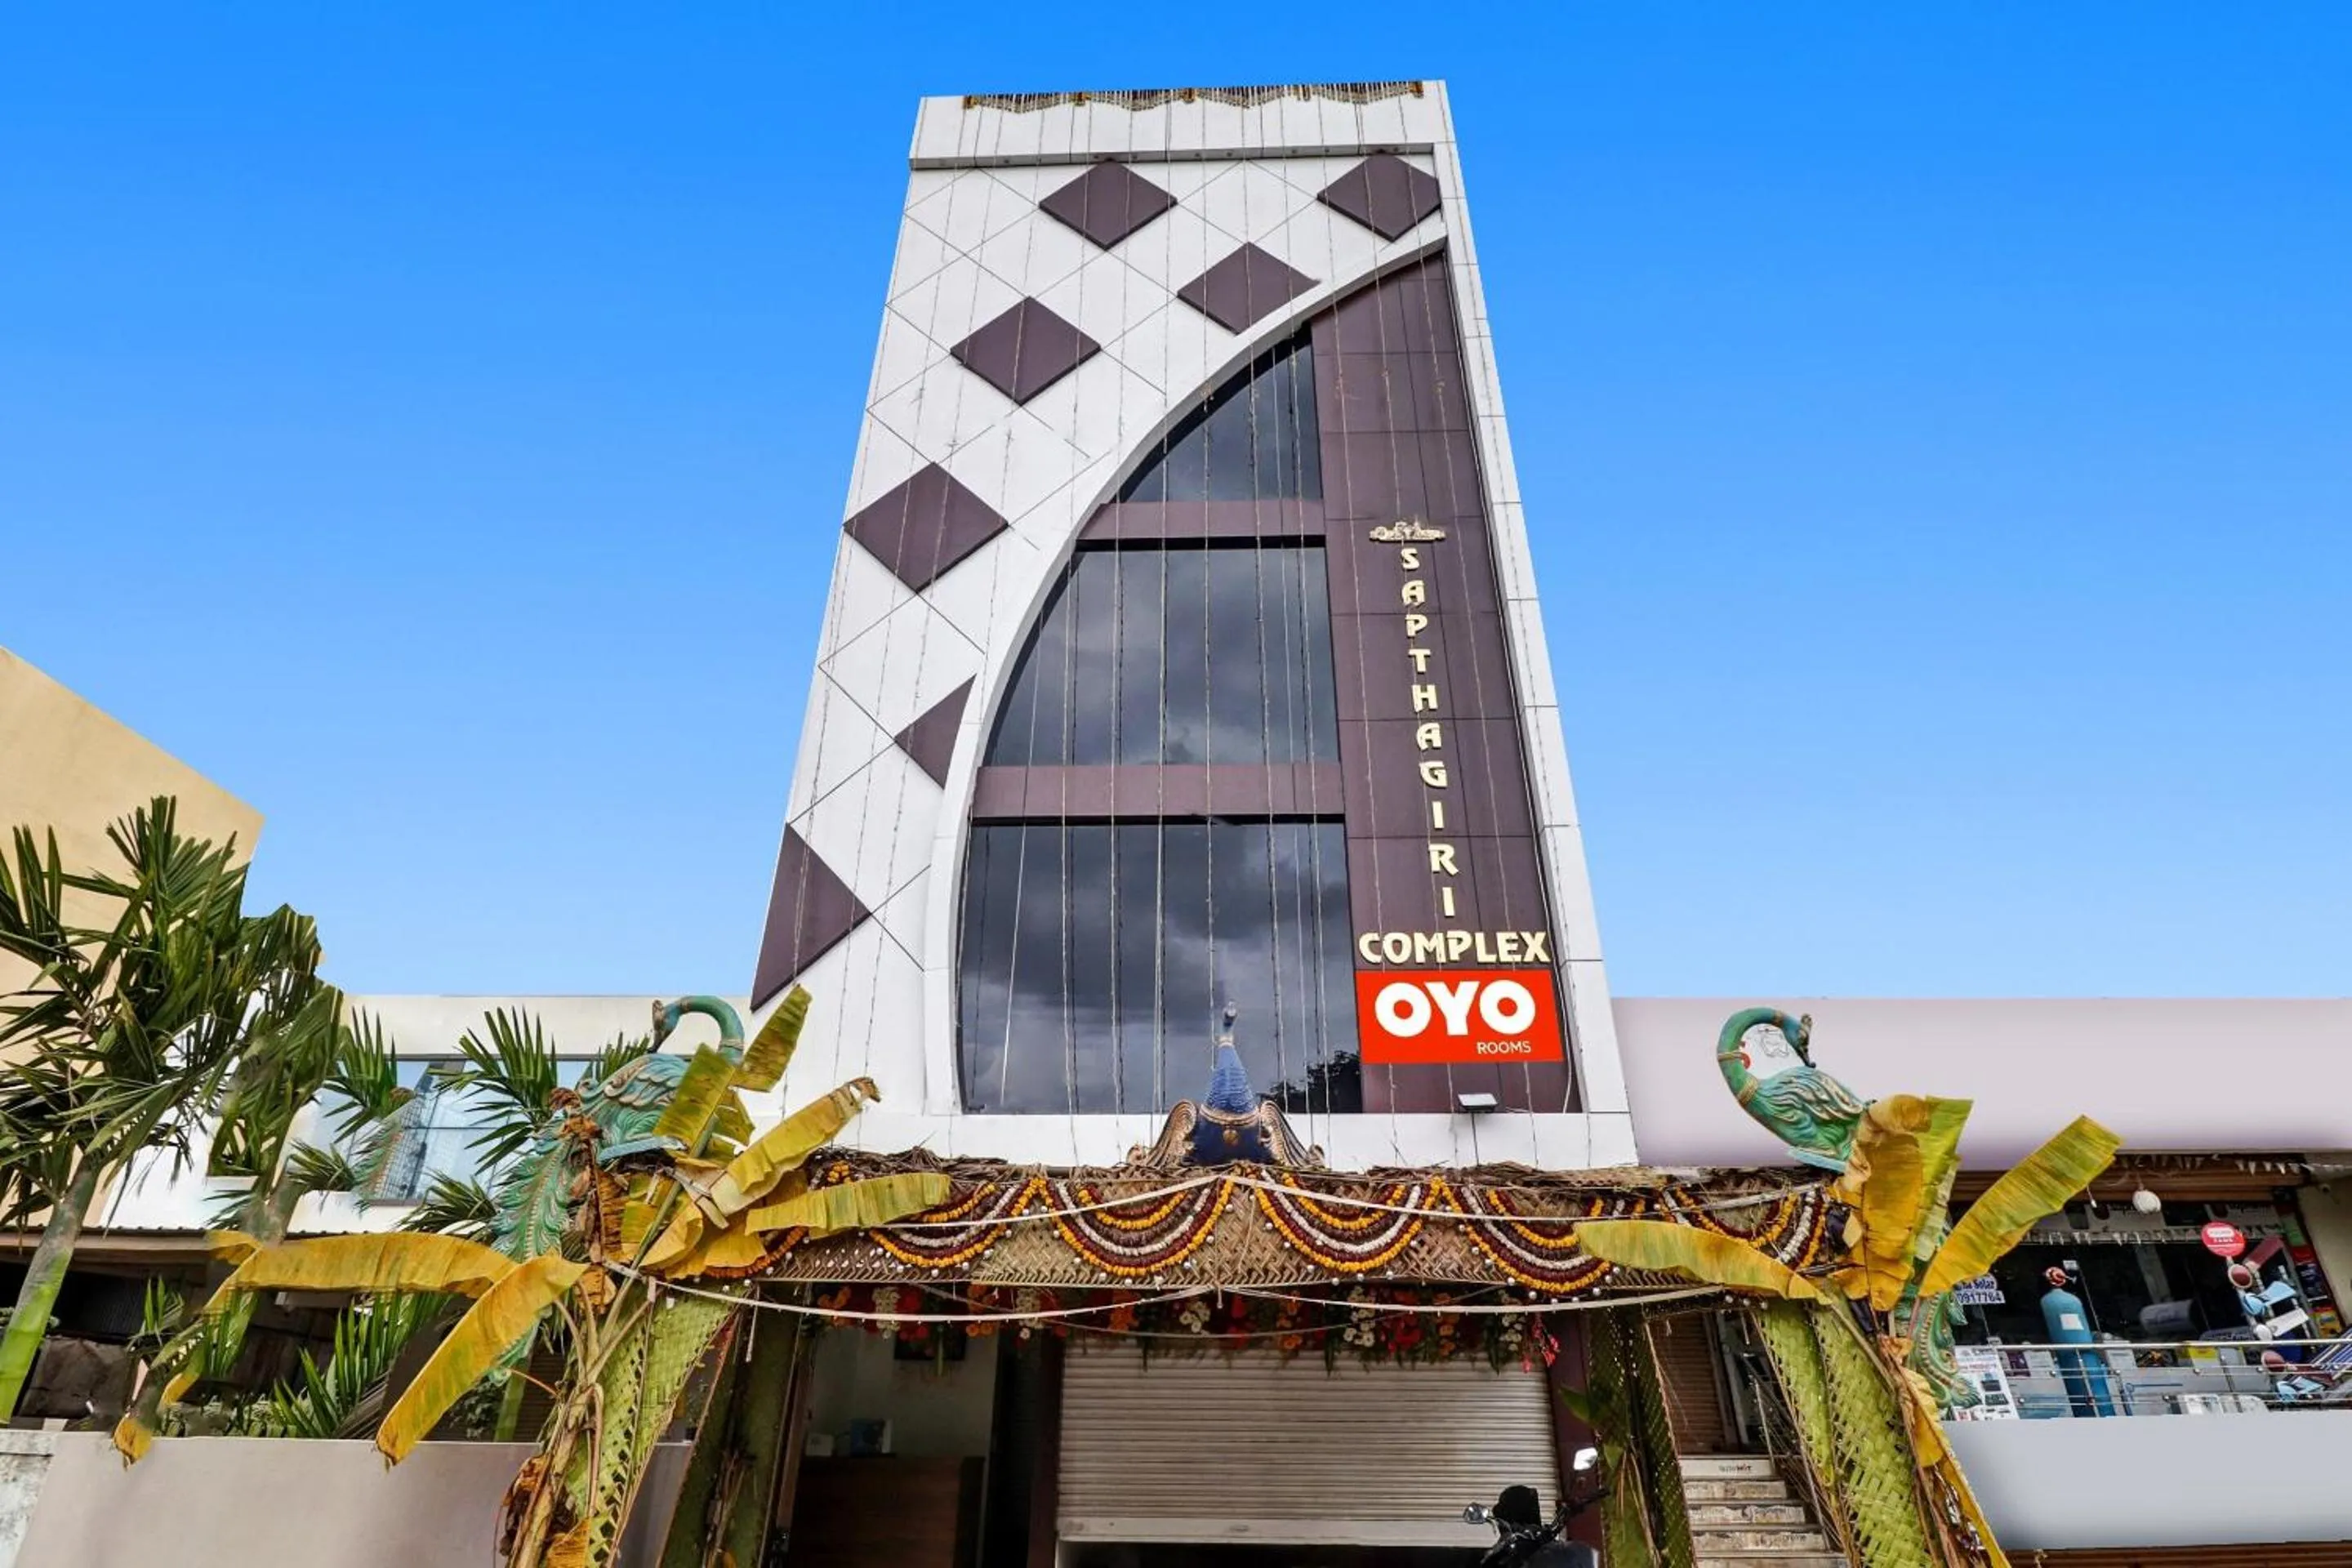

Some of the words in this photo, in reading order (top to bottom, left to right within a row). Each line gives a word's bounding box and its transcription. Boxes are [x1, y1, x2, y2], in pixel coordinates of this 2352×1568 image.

[1400, 547, 1459, 917] SAPTHAGIRI
[1359, 929, 1551, 964] COMPLEX
[1374, 980, 1536, 1038] OYO
[1477, 1040, 1532, 1054] ROOMS
